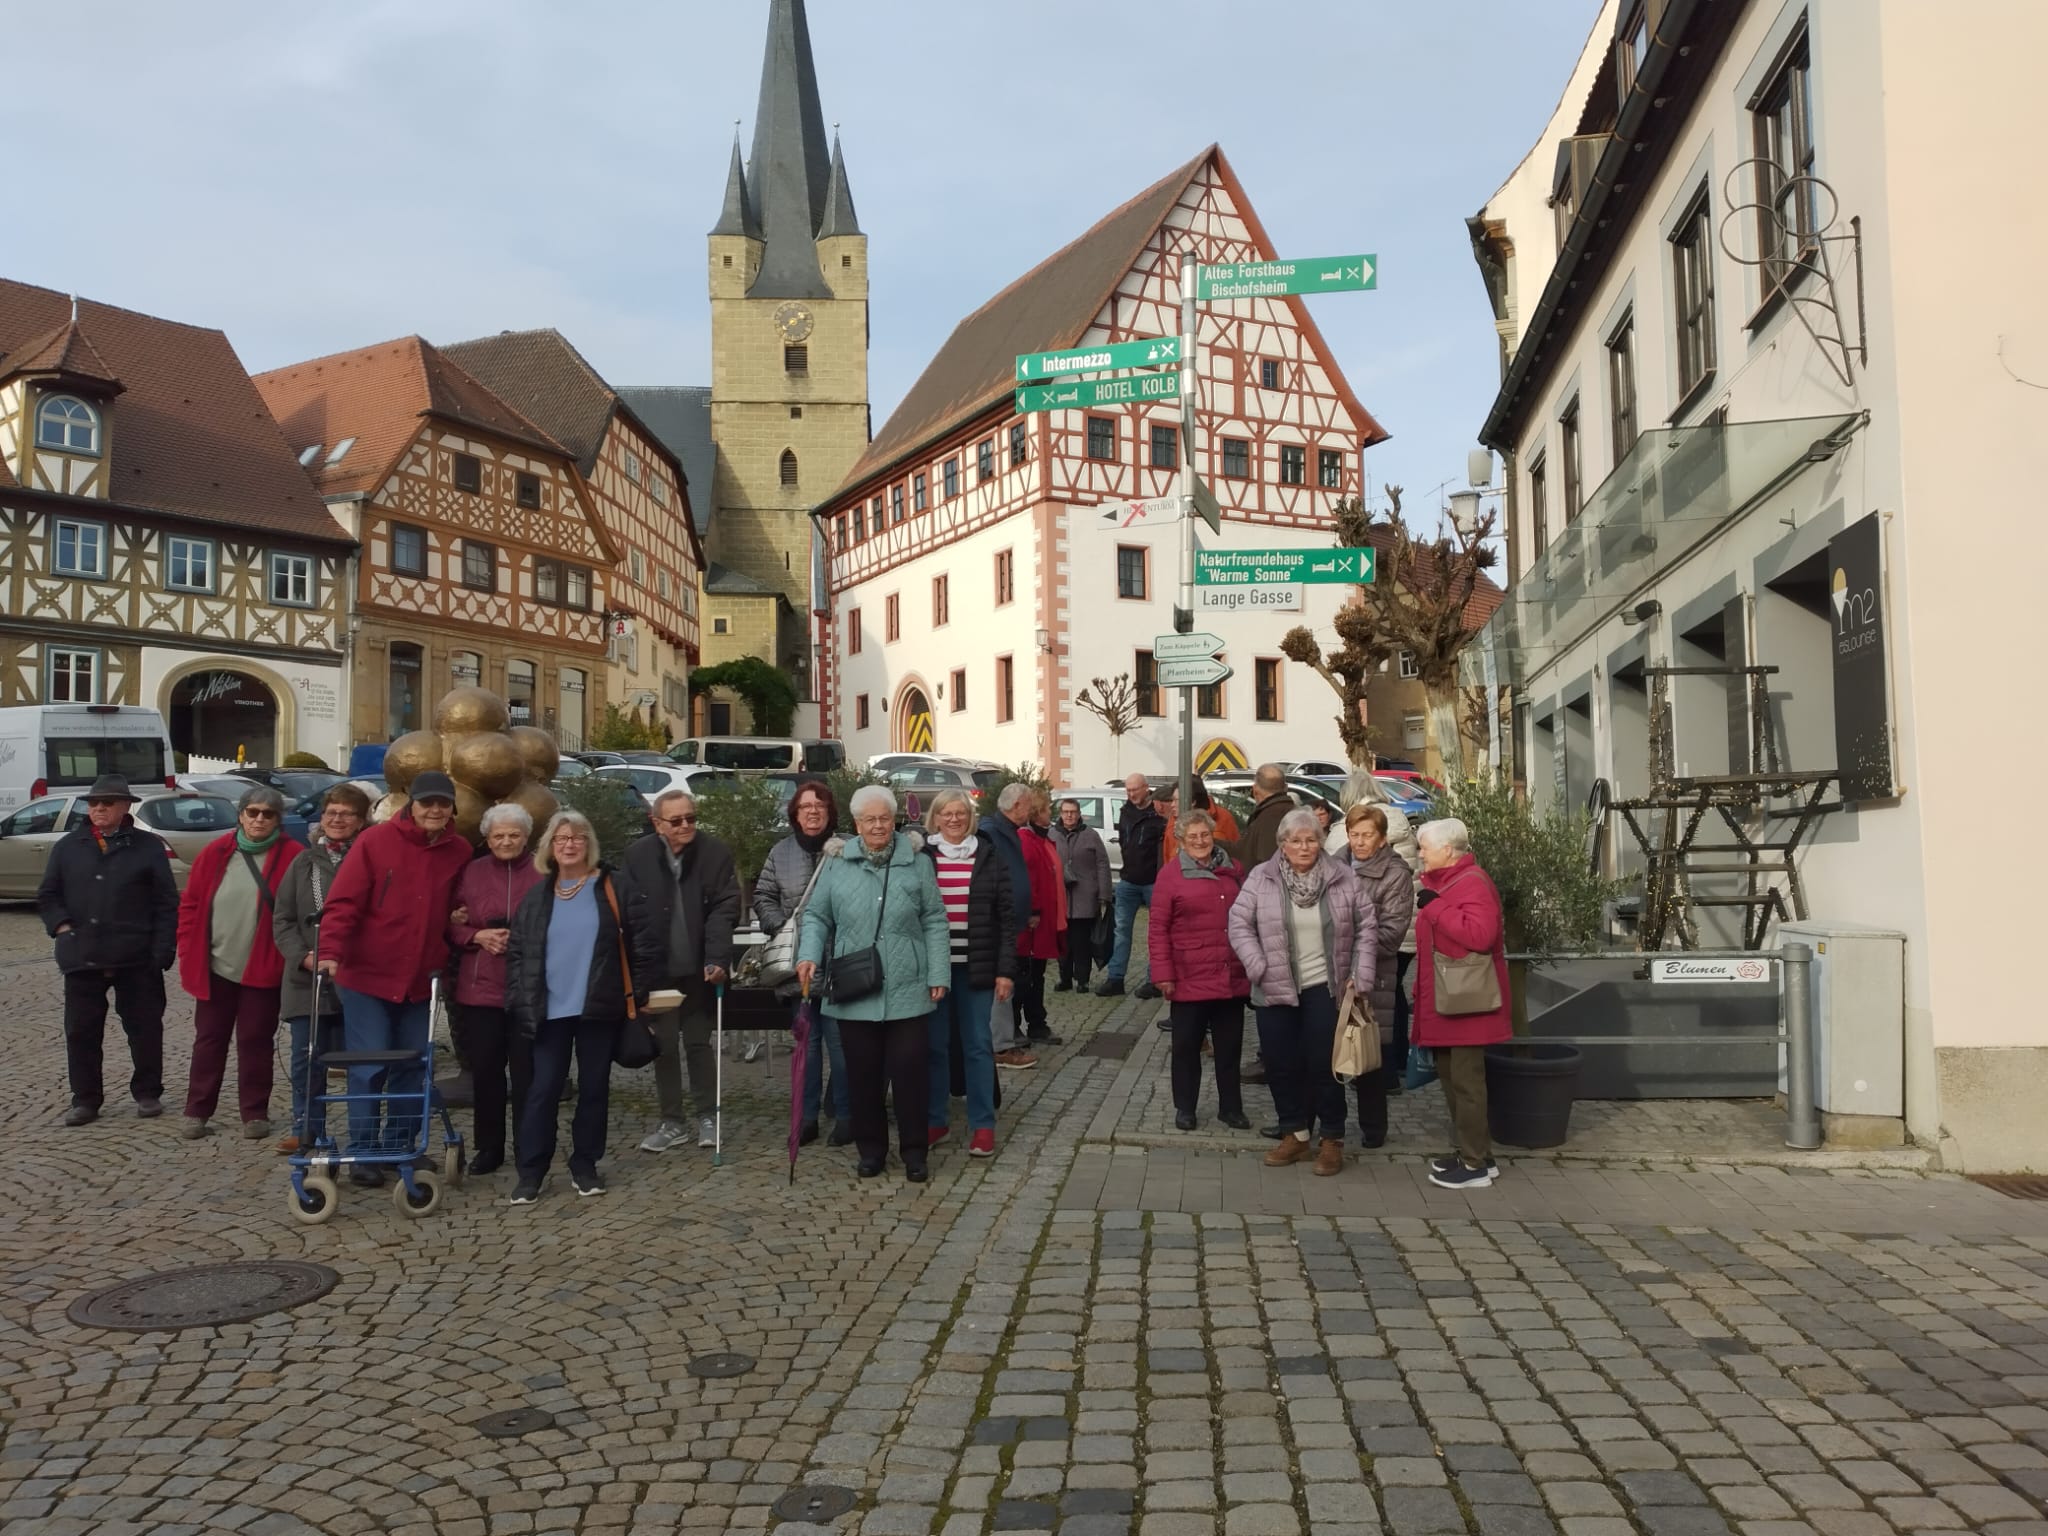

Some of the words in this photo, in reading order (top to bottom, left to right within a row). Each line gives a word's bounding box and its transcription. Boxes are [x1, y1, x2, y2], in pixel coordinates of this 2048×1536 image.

[1205, 266, 1234, 281] Altes
[1239, 262, 1296, 278] Forsthaus
[1211, 280, 1288, 297] Bischofsheim
[1042, 352, 1112, 373] Intermezzo
[1095, 381, 1136, 401] HOTEL
[1142, 376, 1176, 396] KOLB
[1200, 551, 1305, 567] Naturfreundehaus
[1202, 589, 1246, 609] Lange
[1250, 588, 1293, 605] Gasse
[1665, 961, 1728, 974] Blumen
